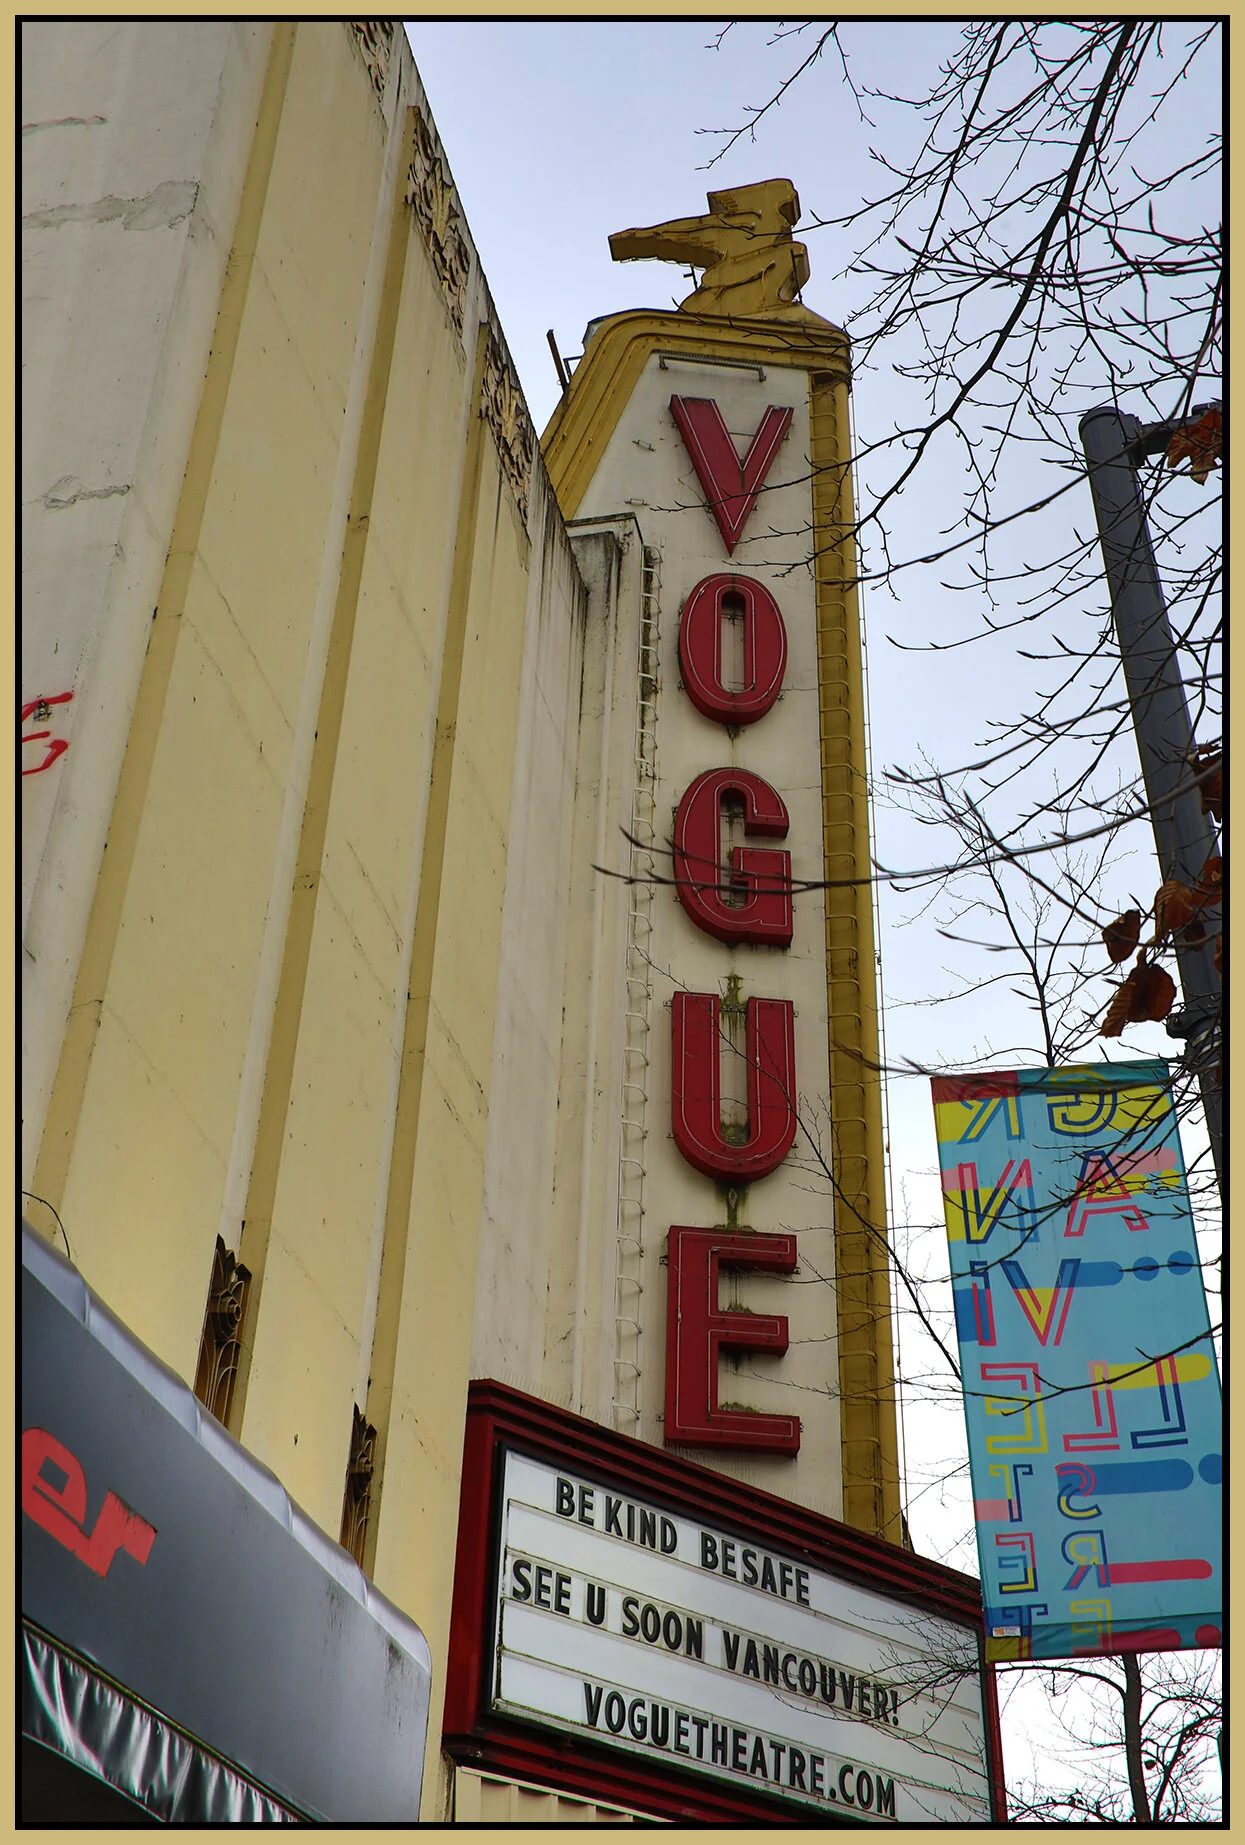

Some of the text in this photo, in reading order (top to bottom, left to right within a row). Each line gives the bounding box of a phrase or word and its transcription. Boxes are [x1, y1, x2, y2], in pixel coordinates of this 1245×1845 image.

[664, 394, 800, 1459] VOGUE
[512, 1559, 899, 1727] SEE U SOON VANCOUVER!
[583, 1682, 896, 1818] VOGUETHEATRE.COM
